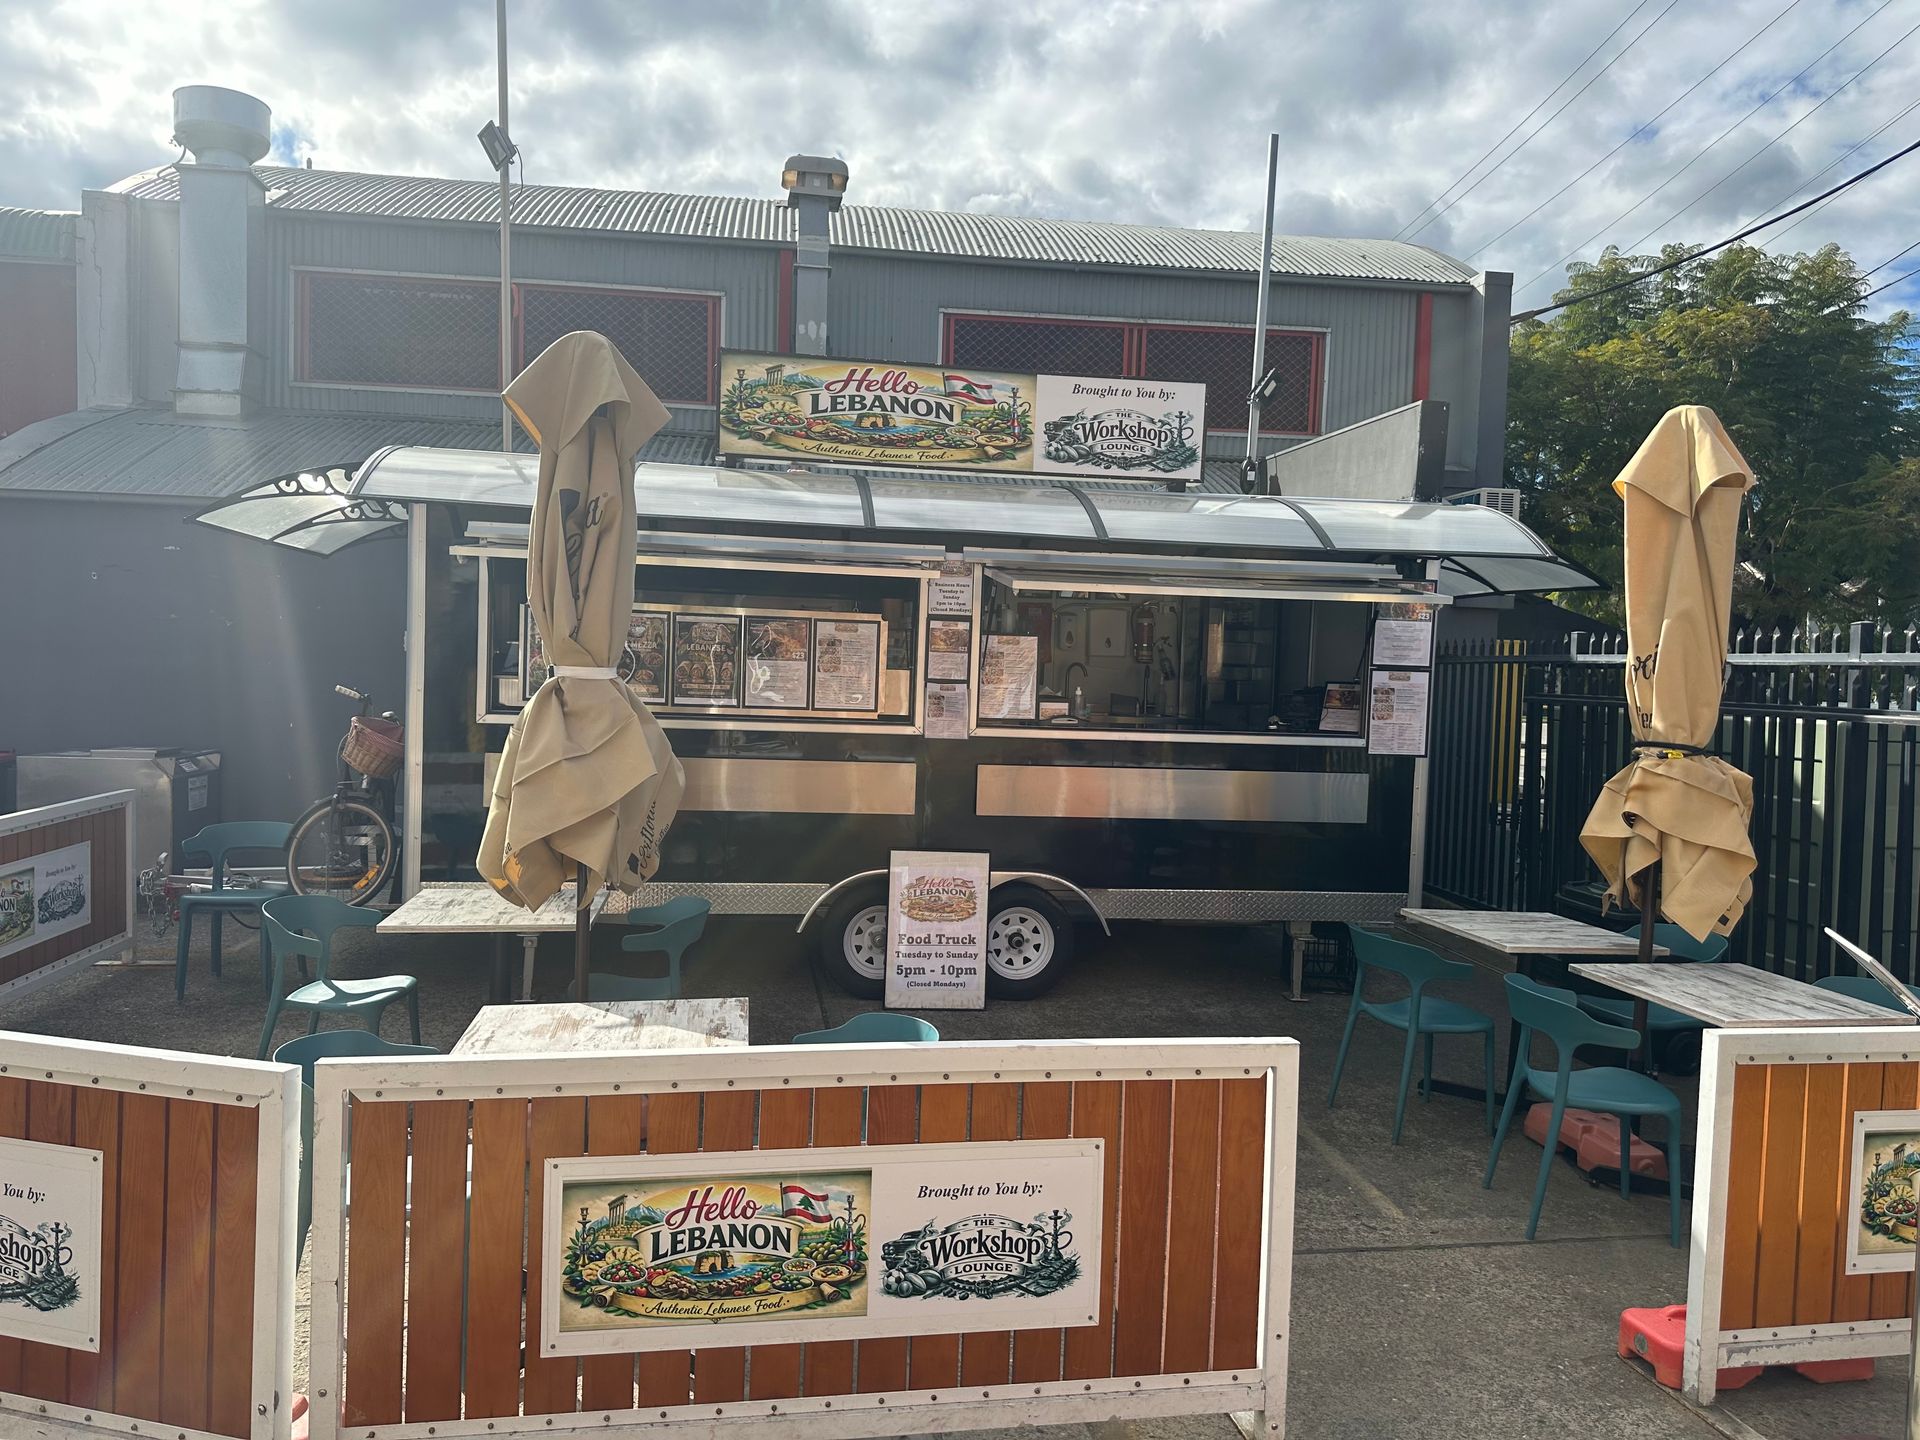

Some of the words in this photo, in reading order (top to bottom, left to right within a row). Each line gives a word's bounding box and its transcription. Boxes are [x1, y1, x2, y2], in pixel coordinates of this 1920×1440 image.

[824, 367, 924, 395] Hello
[1072, 384, 1119, 399] Brought
[1121, 387, 1132, 397] to
[1135, 387, 1156, 399] You
[1158, 389, 1176, 402] by:
[809, 393, 955, 423] LEBANON
[1074, 419, 1169, 448] Workshop
[804, 442, 866, 456] Authentic
[865, 448, 914, 460] Lebanese
[916, 452, 946, 460] Food
[1100, 443, 1147, 453] LOUNGE
[913, 888, 967, 897] LEBANON
[923, 879, 953, 888] Hello
[898, 933, 932, 945] Food
[935, 933, 977, 945] Truck
[895, 951, 932, 960] Tuesday
[946, 951, 979, 960] Sunday
[896, 964, 926, 978] 5pm
[940, 964, 977, 978] 10pm
[906, 981, 932, 989] (Closed
[933, 981, 966, 989] Mondays)
[3, 1183, 24, 1199] You
[27, 1187, 46, 1204] by:
[917, 1184, 975, 1200] Brought
[977, 1185, 990, 1196] to
[995, 1182, 1018, 1195] You
[1022, 1182, 1043, 1197] by:
[664, 1186, 762, 1230] Hello
[650, 1223, 792, 1263] LEBANON
[919, 1229, 1041, 1267] Workshop
[954, 1263, 1014, 1275] LOUNGE
[645, 1301, 703, 1315] Authentic
[703, 1303, 751, 1316] Lebanese
[754, 1298, 783, 1312] Food
